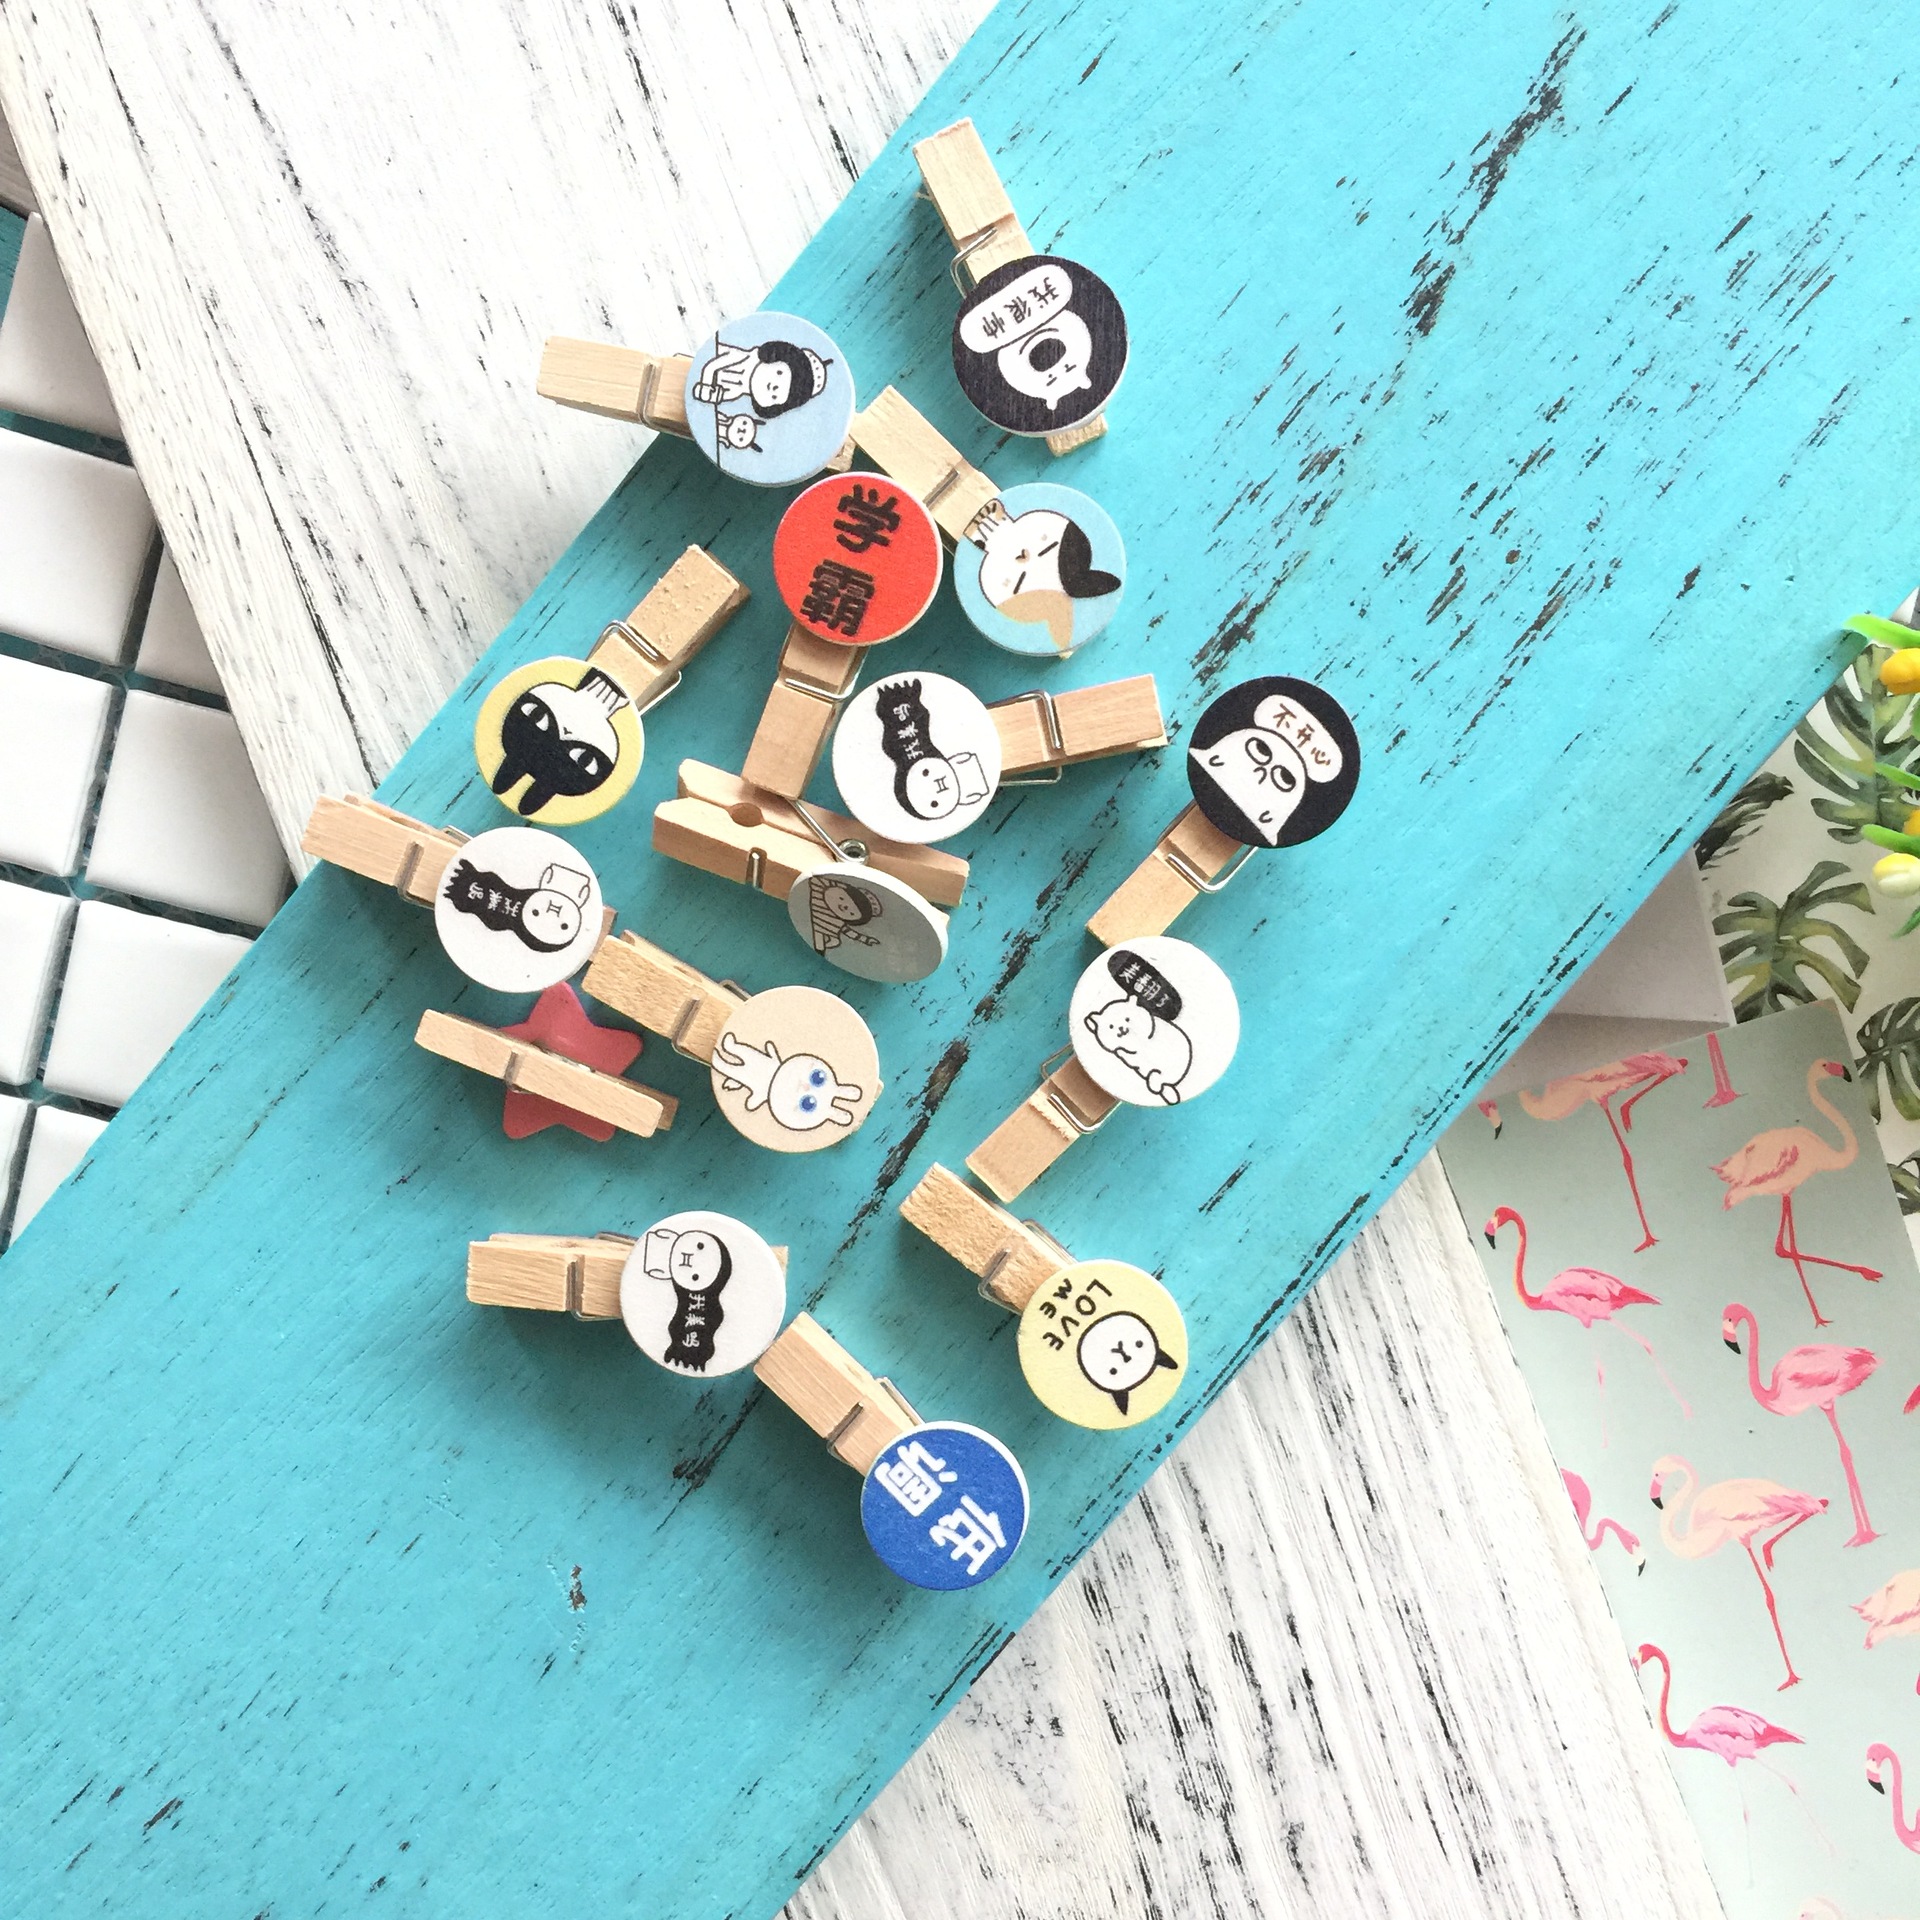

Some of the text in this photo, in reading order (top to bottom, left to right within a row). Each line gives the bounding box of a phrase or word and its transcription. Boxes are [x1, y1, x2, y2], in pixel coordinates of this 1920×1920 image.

[982, 276, 1060, 339] 我很帅
[799, 483, 903, 637] 学霸
[892, 702, 925, 761] 我美吗
[1272, 702, 1332, 767] 不开心
[467, 881, 523, 918] 我美吗
[1118, 961, 1173, 1009] 美翻了
[681, 1292, 706, 1348] 我美吗
[1038, 1277, 1073, 1320] ME
[1042, 1278, 1113, 1352] LOVE
[873, 1440, 1008, 1577] 低调
